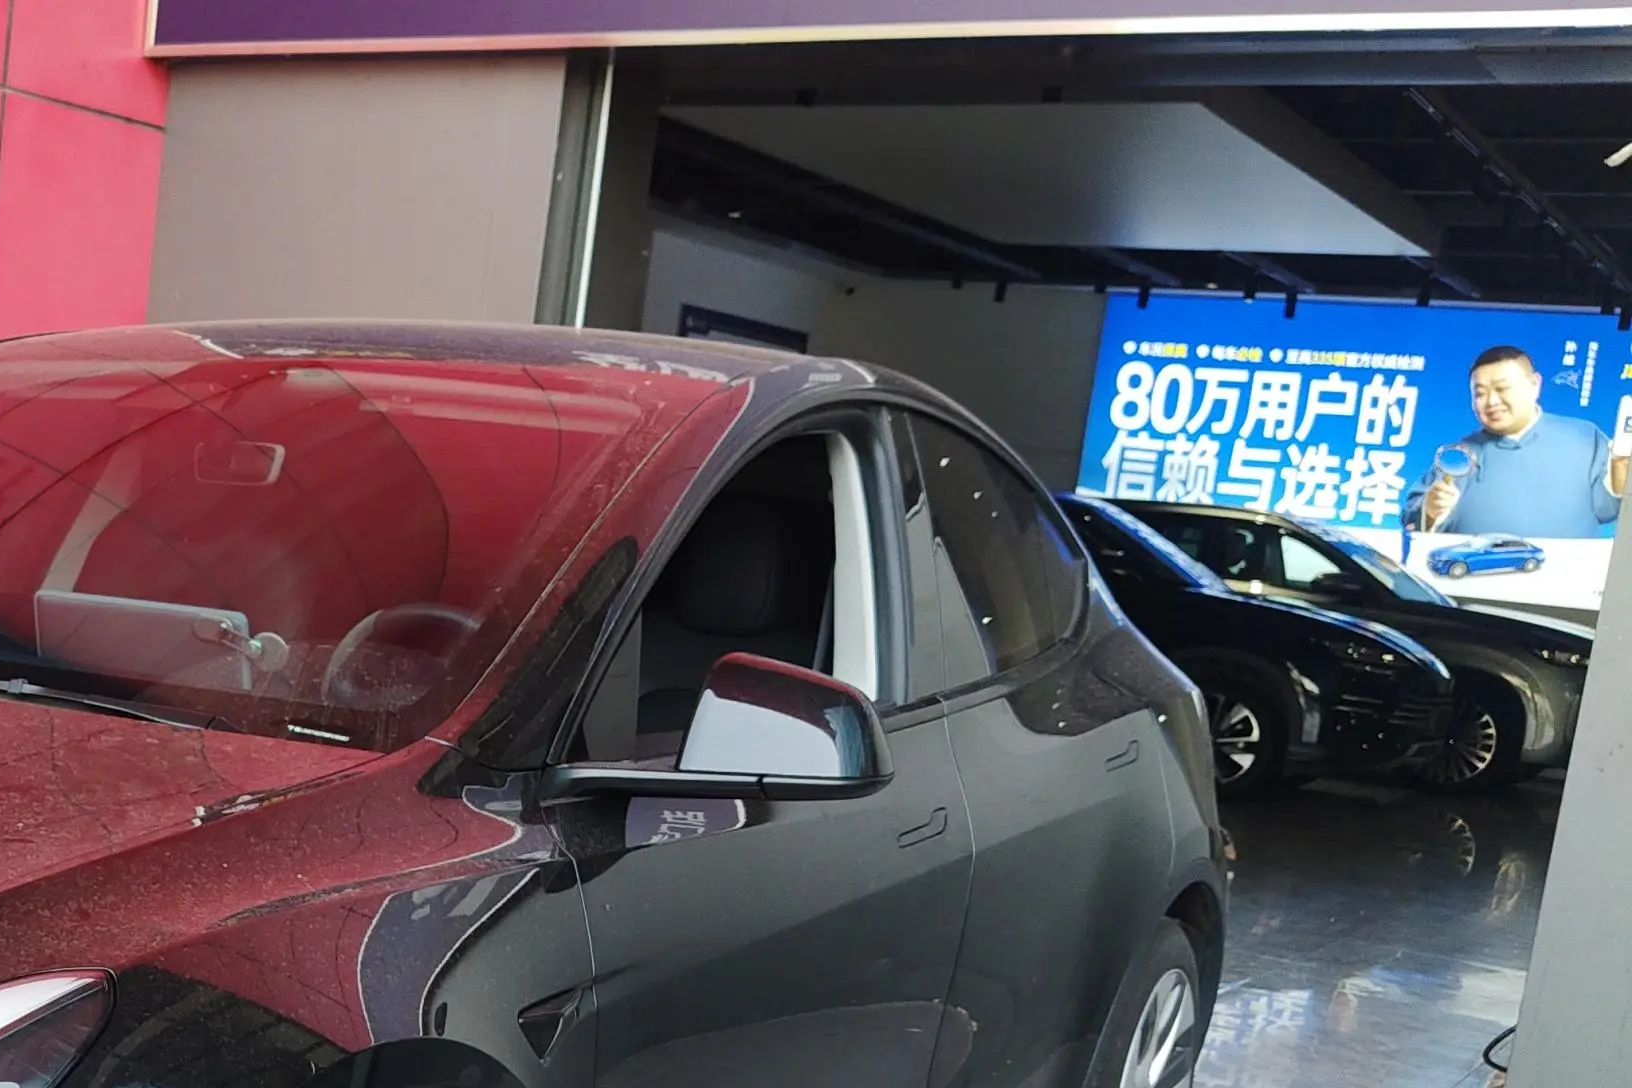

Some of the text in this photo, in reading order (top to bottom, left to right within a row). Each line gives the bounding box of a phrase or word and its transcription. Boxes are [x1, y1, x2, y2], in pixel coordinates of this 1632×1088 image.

[1110, 360, 1420, 448] 80万用户的
[1101, 430, 1407, 524] 信赖与选择
